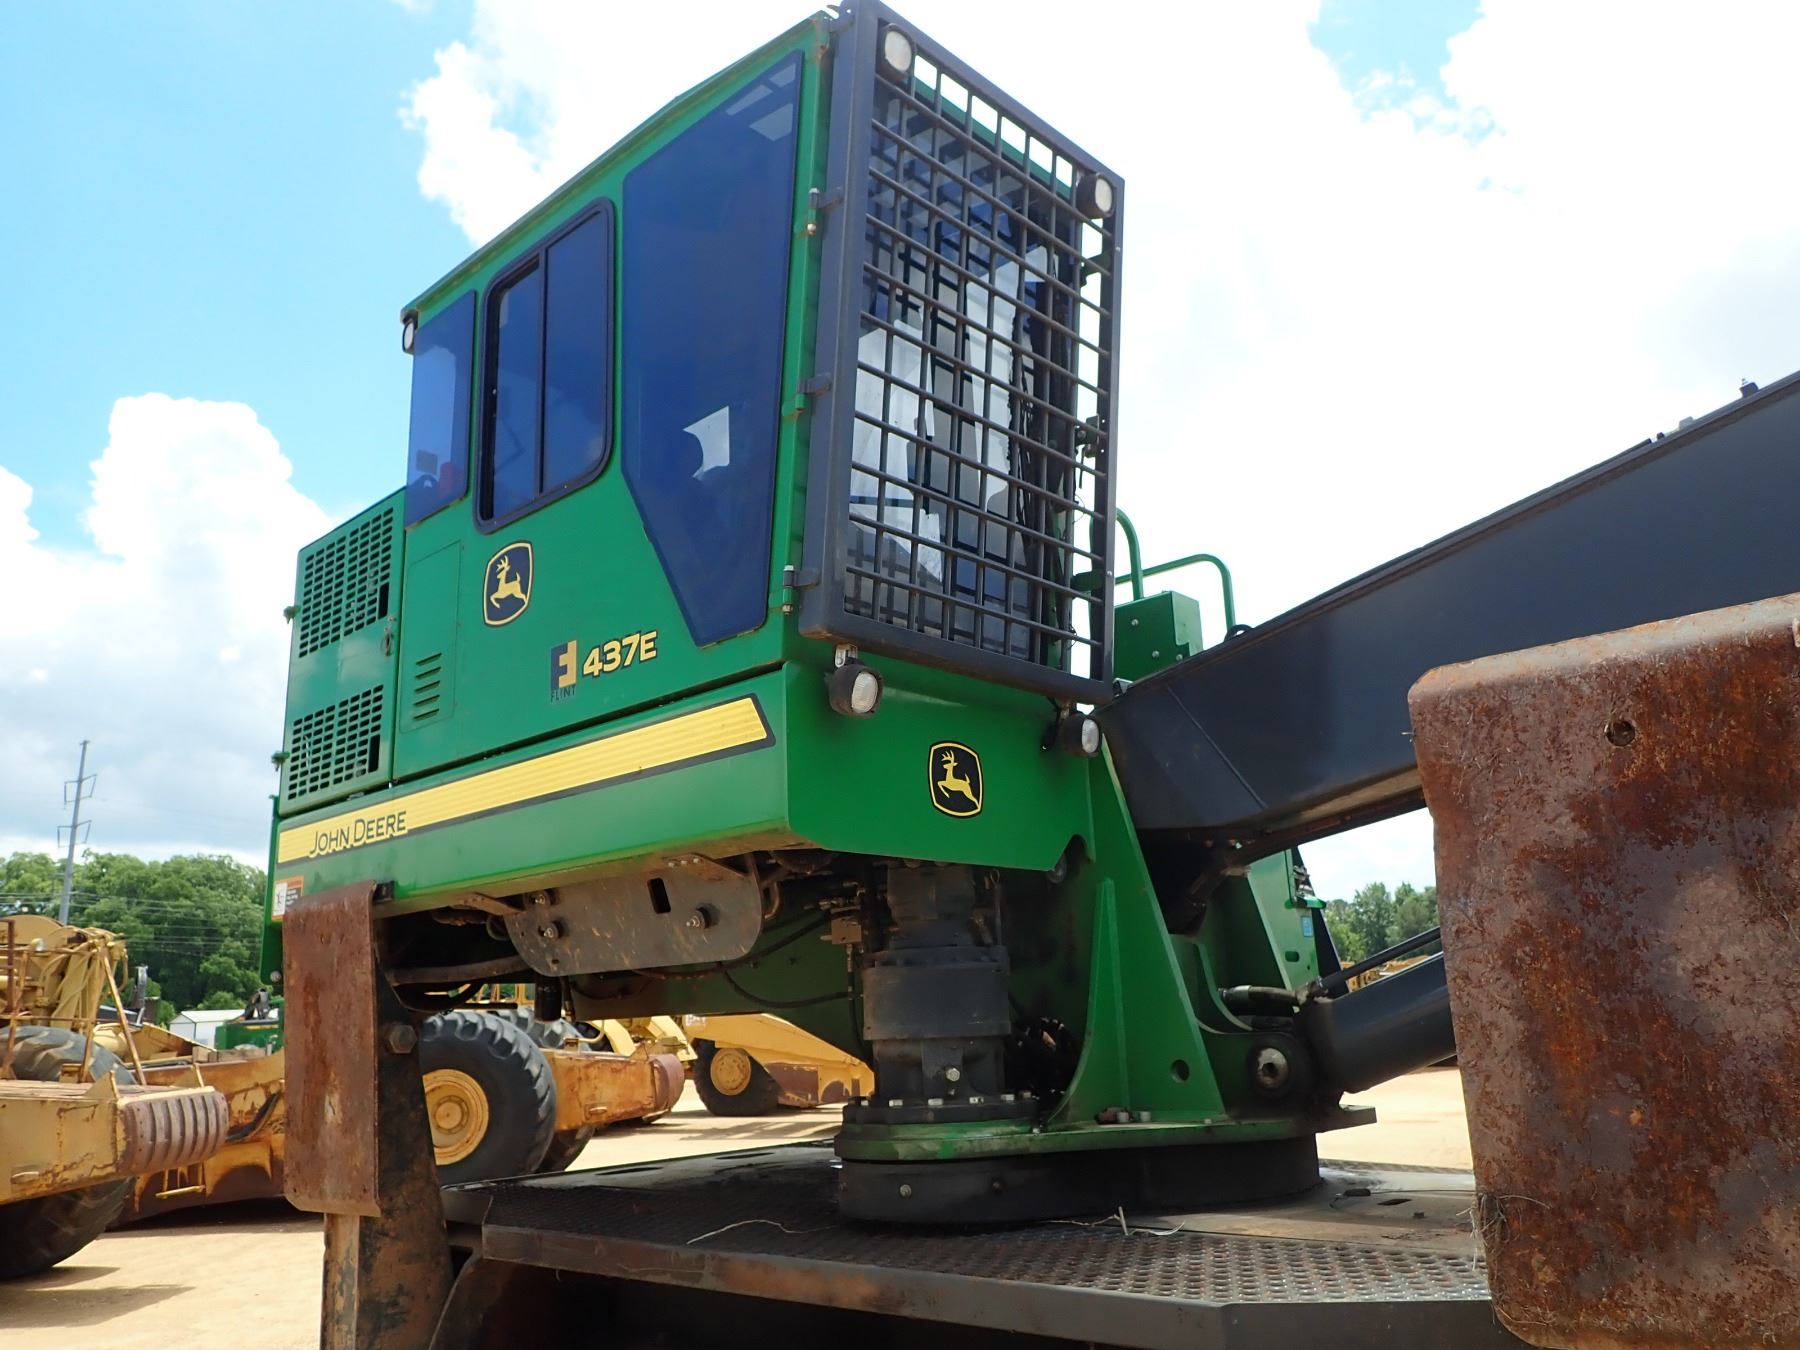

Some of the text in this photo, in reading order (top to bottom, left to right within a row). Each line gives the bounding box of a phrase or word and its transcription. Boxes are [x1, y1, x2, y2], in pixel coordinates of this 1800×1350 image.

[582, 630, 657, 677] 437E
[550, 684, 576, 702] FLINT
[310, 810, 407, 855] JOHN DEERE
